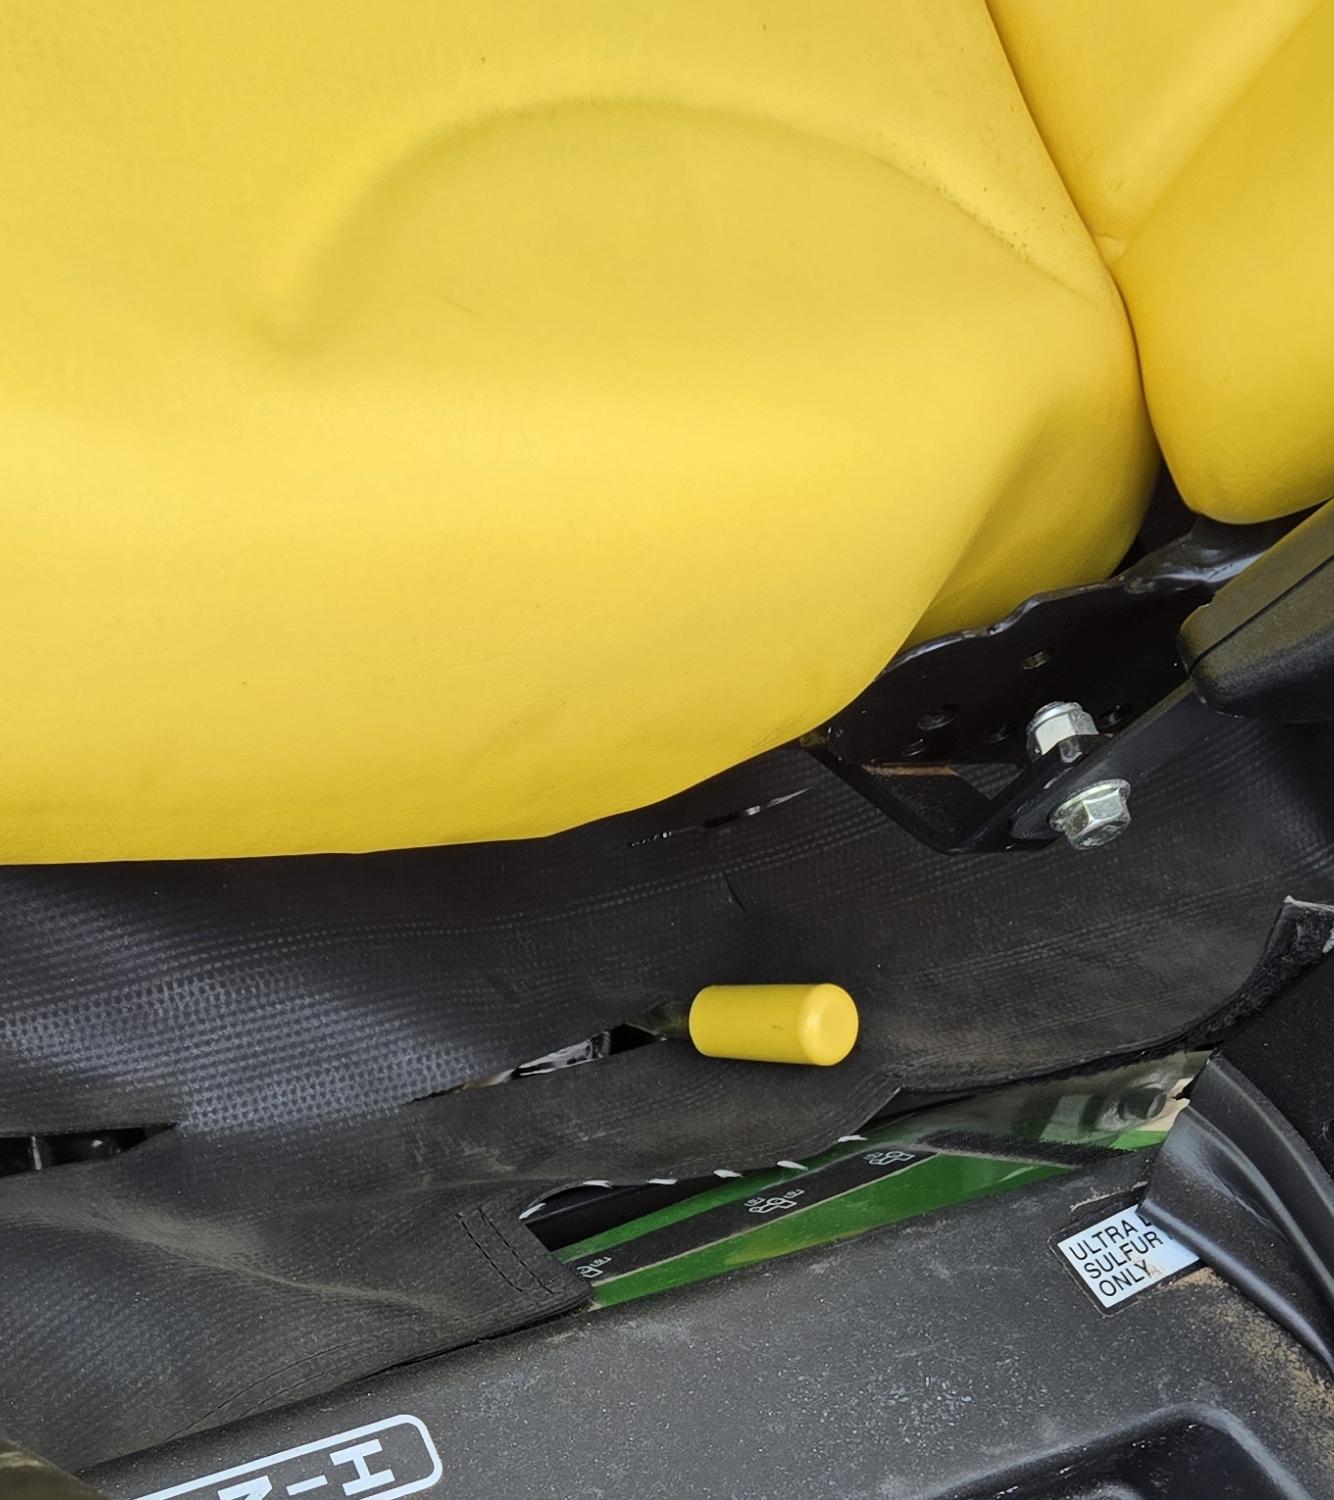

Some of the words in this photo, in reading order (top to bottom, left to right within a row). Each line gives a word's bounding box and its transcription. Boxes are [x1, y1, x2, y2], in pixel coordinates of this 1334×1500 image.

[1069, 1219, 1139, 1261] ULTRA
[1083, 1230, 1164, 1279] SULFUR
[1099, 1259, 1152, 1297] ONLY
